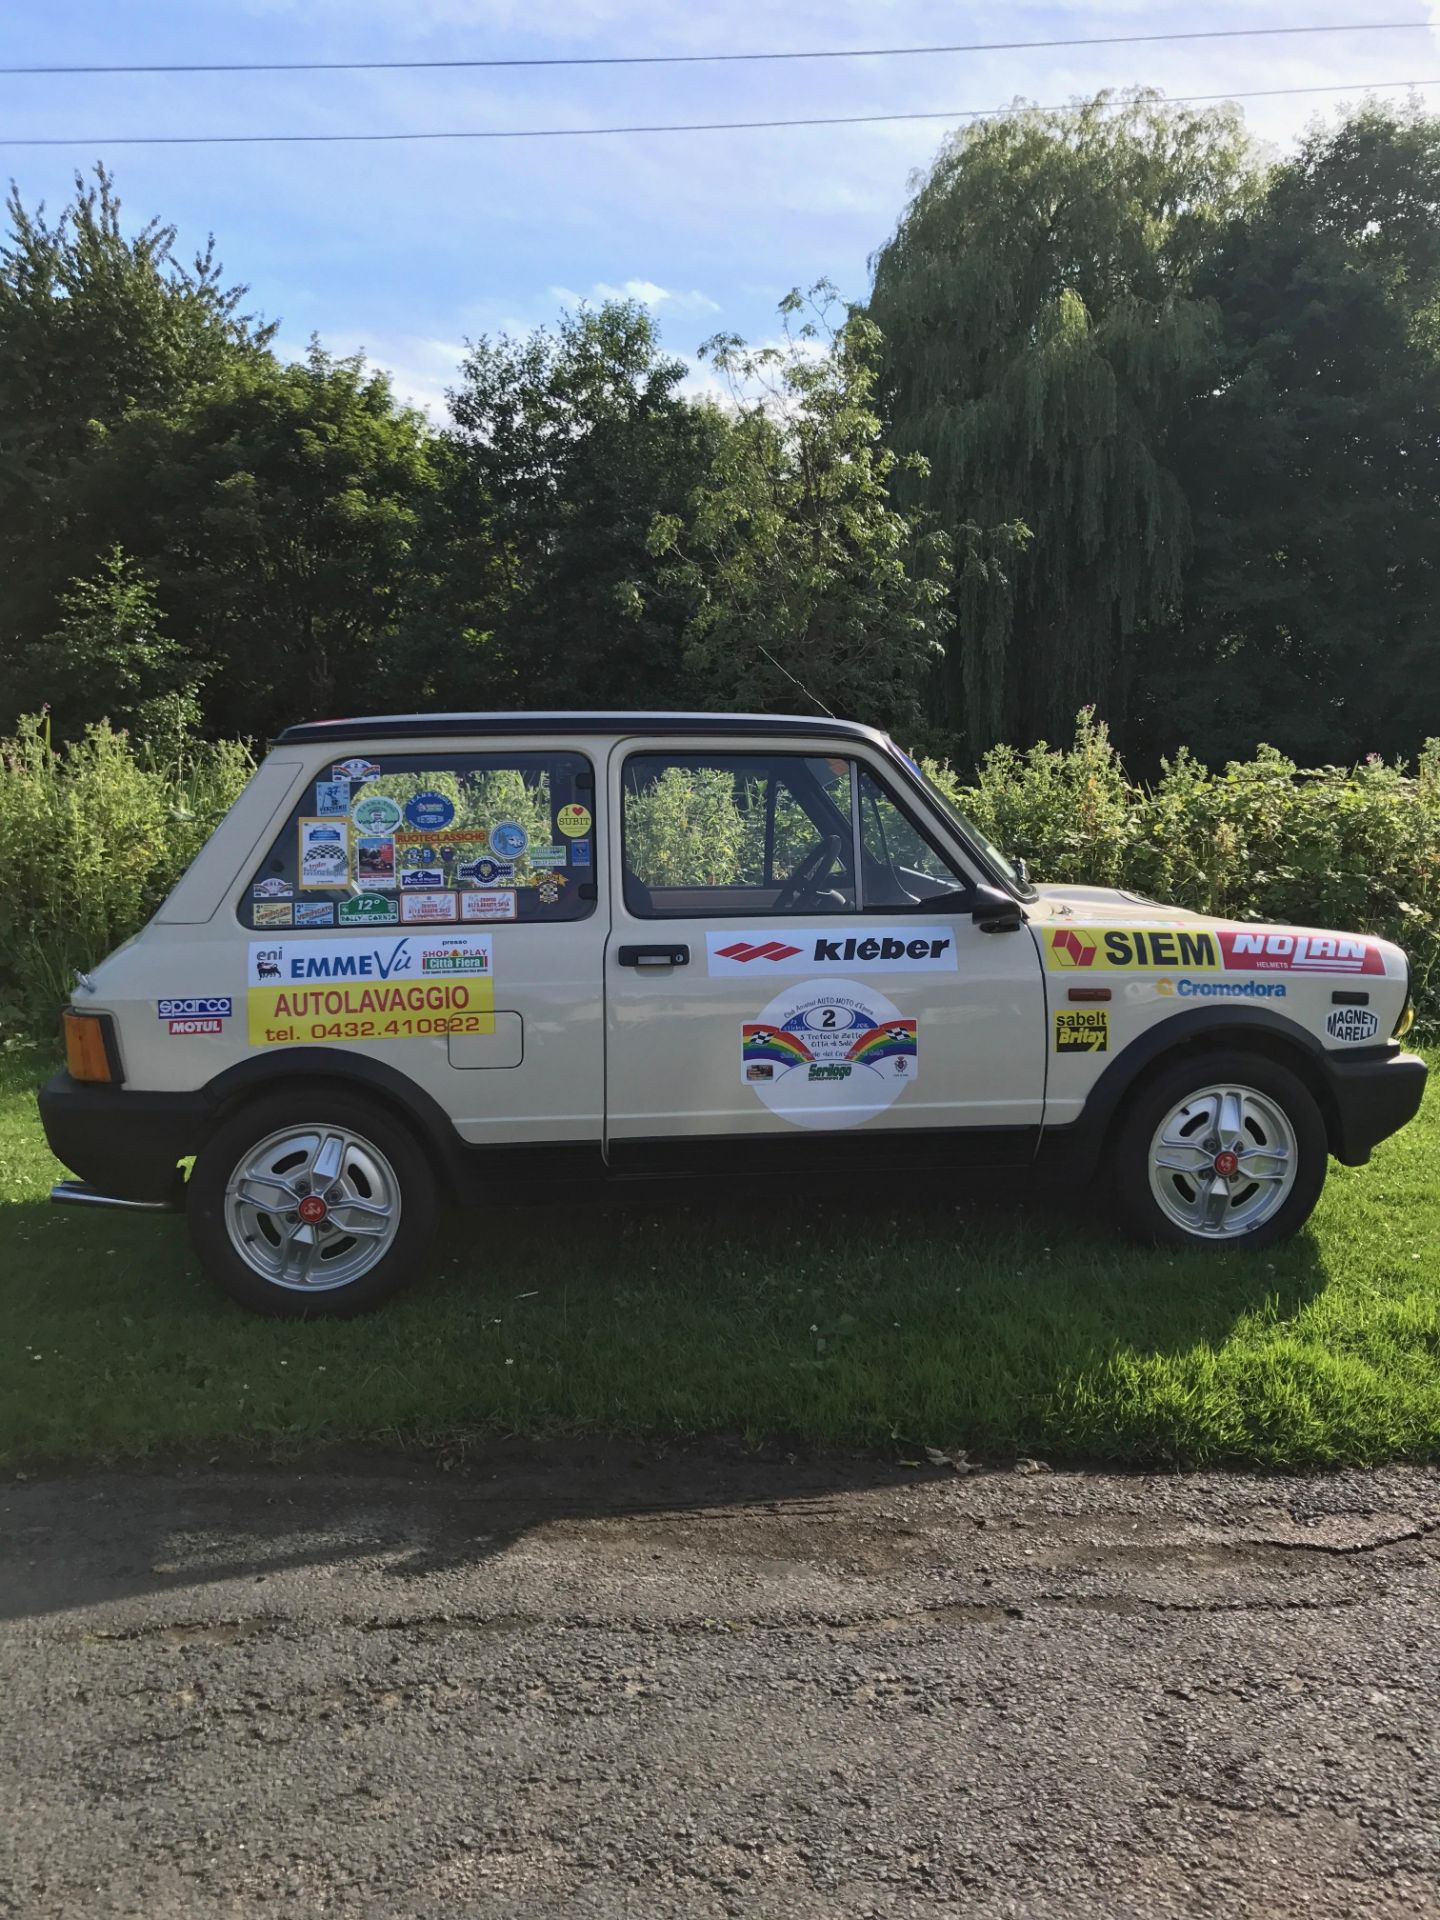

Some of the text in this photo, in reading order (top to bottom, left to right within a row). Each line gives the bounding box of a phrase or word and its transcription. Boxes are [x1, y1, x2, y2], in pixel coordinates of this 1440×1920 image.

[559, 817, 589, 826] SUBIT
[358, 899, 381, 910] 12°
[256, 946, 283, 961] eni
[813, 938, 950, 961] kléber
[1104, 931, 1216, 967] SIEM
[1232, 934, 1368, 964] NOLAN
[456, 957, 481, 968] Fiera
[1256, 961, 1289, 969] HELMETS
[1177, 979, 1287, 997] Cromodora
[160, 999, 230, 1017] sparco
[273, 985, 469, 1018] AUTOLAVAGGIO
[172, 1021, 220, 1032] MOTUL
[822, 1009, 836, 1028] 2
[1056, 1011, 1107, 1027] sabelt
[265, 1017, 480, 1042] tel. 0432.410822
[1058, 1027, 1106, 1049] Britax
